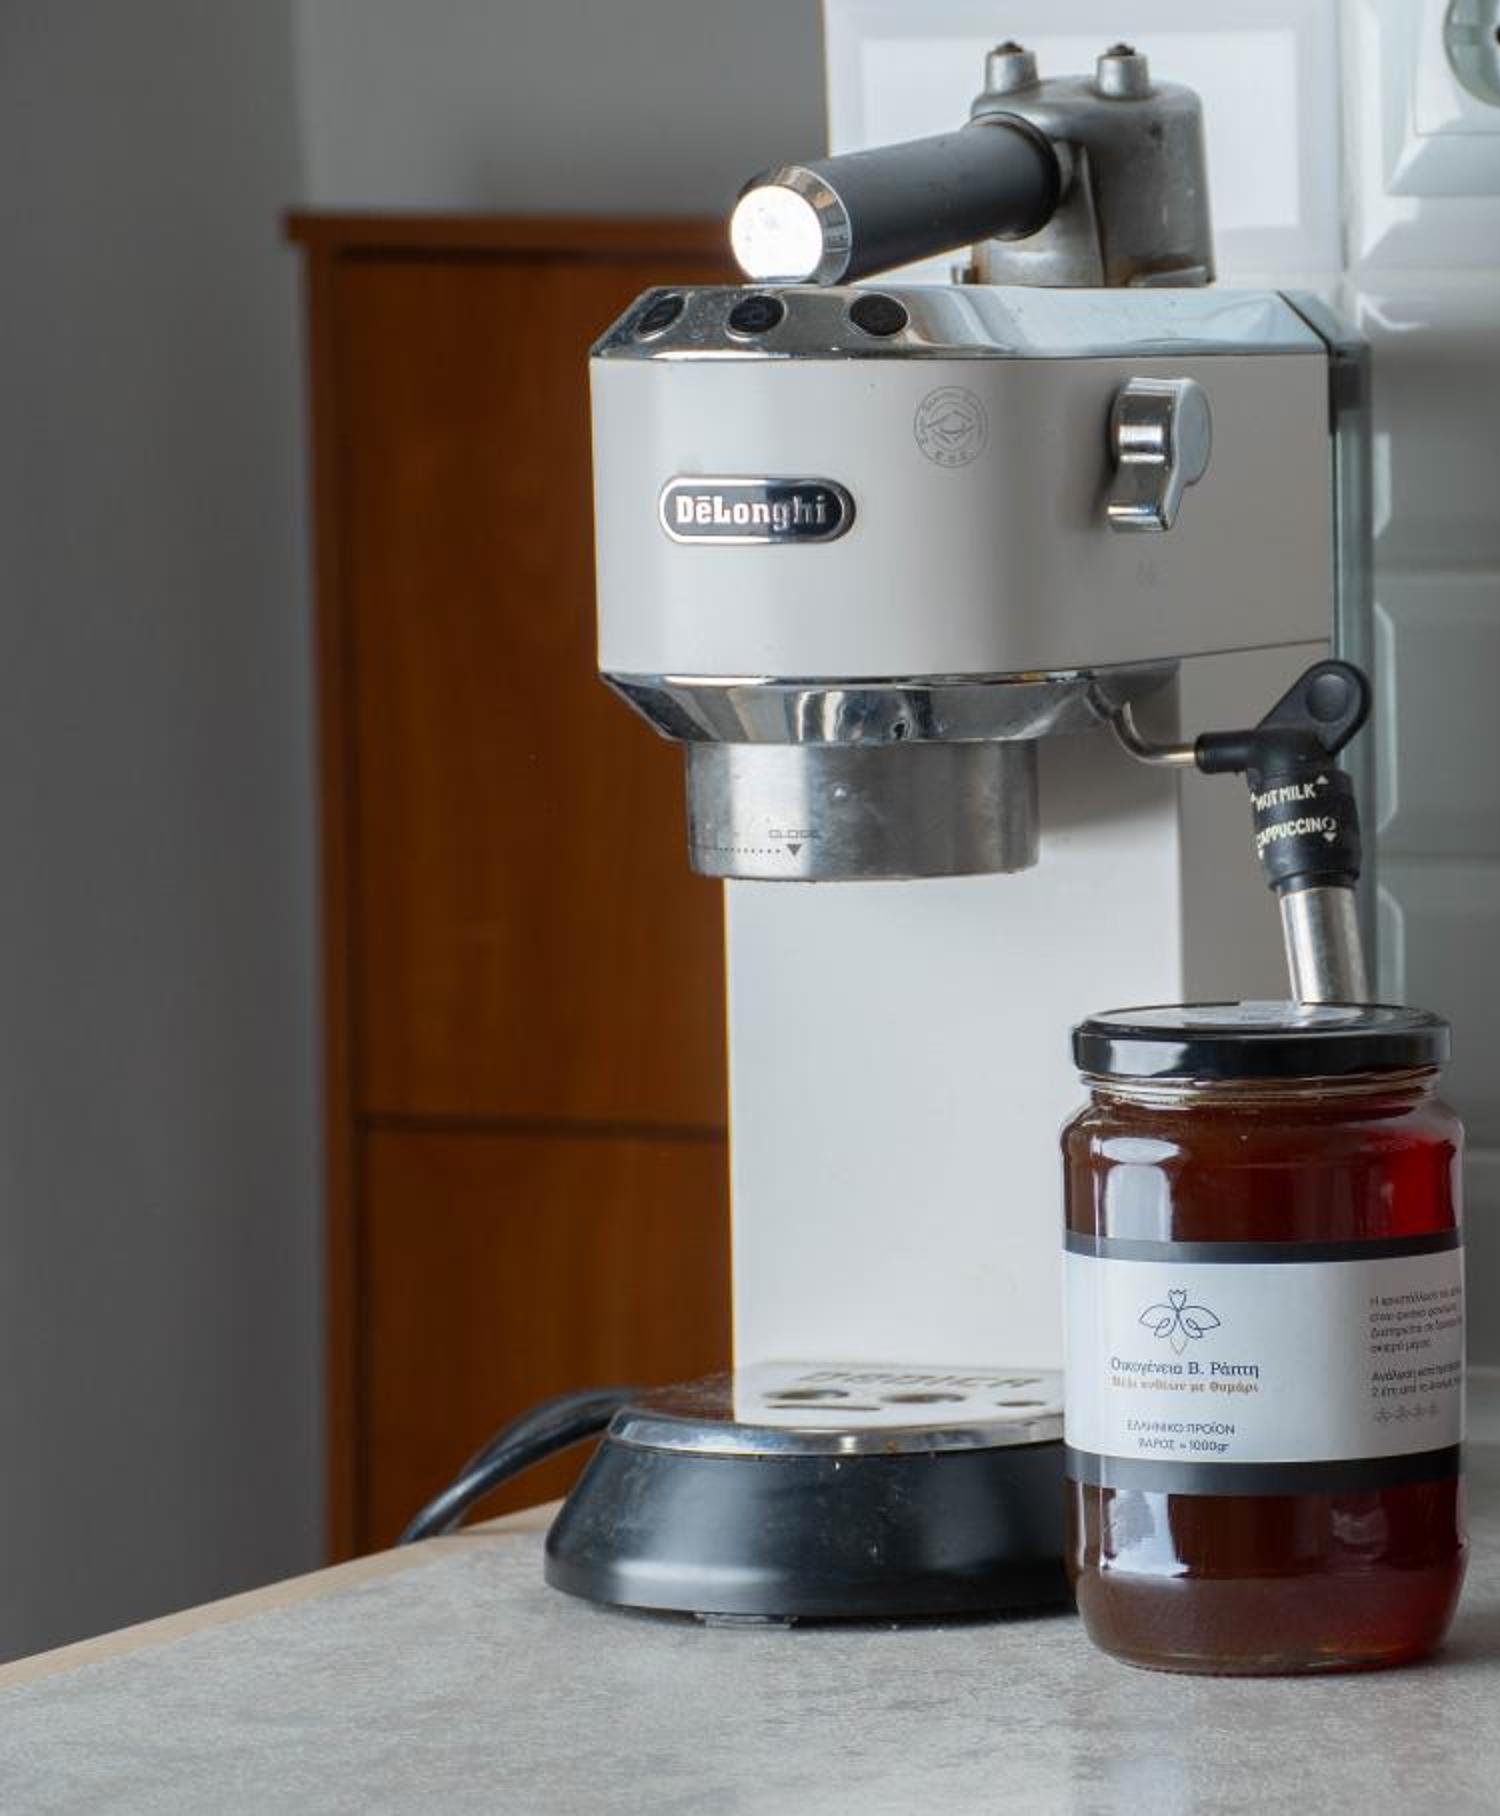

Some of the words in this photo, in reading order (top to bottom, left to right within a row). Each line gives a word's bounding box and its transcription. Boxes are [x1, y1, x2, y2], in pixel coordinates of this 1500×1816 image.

[1279, 783, 1316, 803] MILK
[1256, 816, 1337, 849] CAPPUCCINO
[1111, 1357, 1183, 1376] Οικογένεια
[1187, 1361, 1205, 1375] Β.
[1210, 1361, 1260, 1379] Ράπτη
